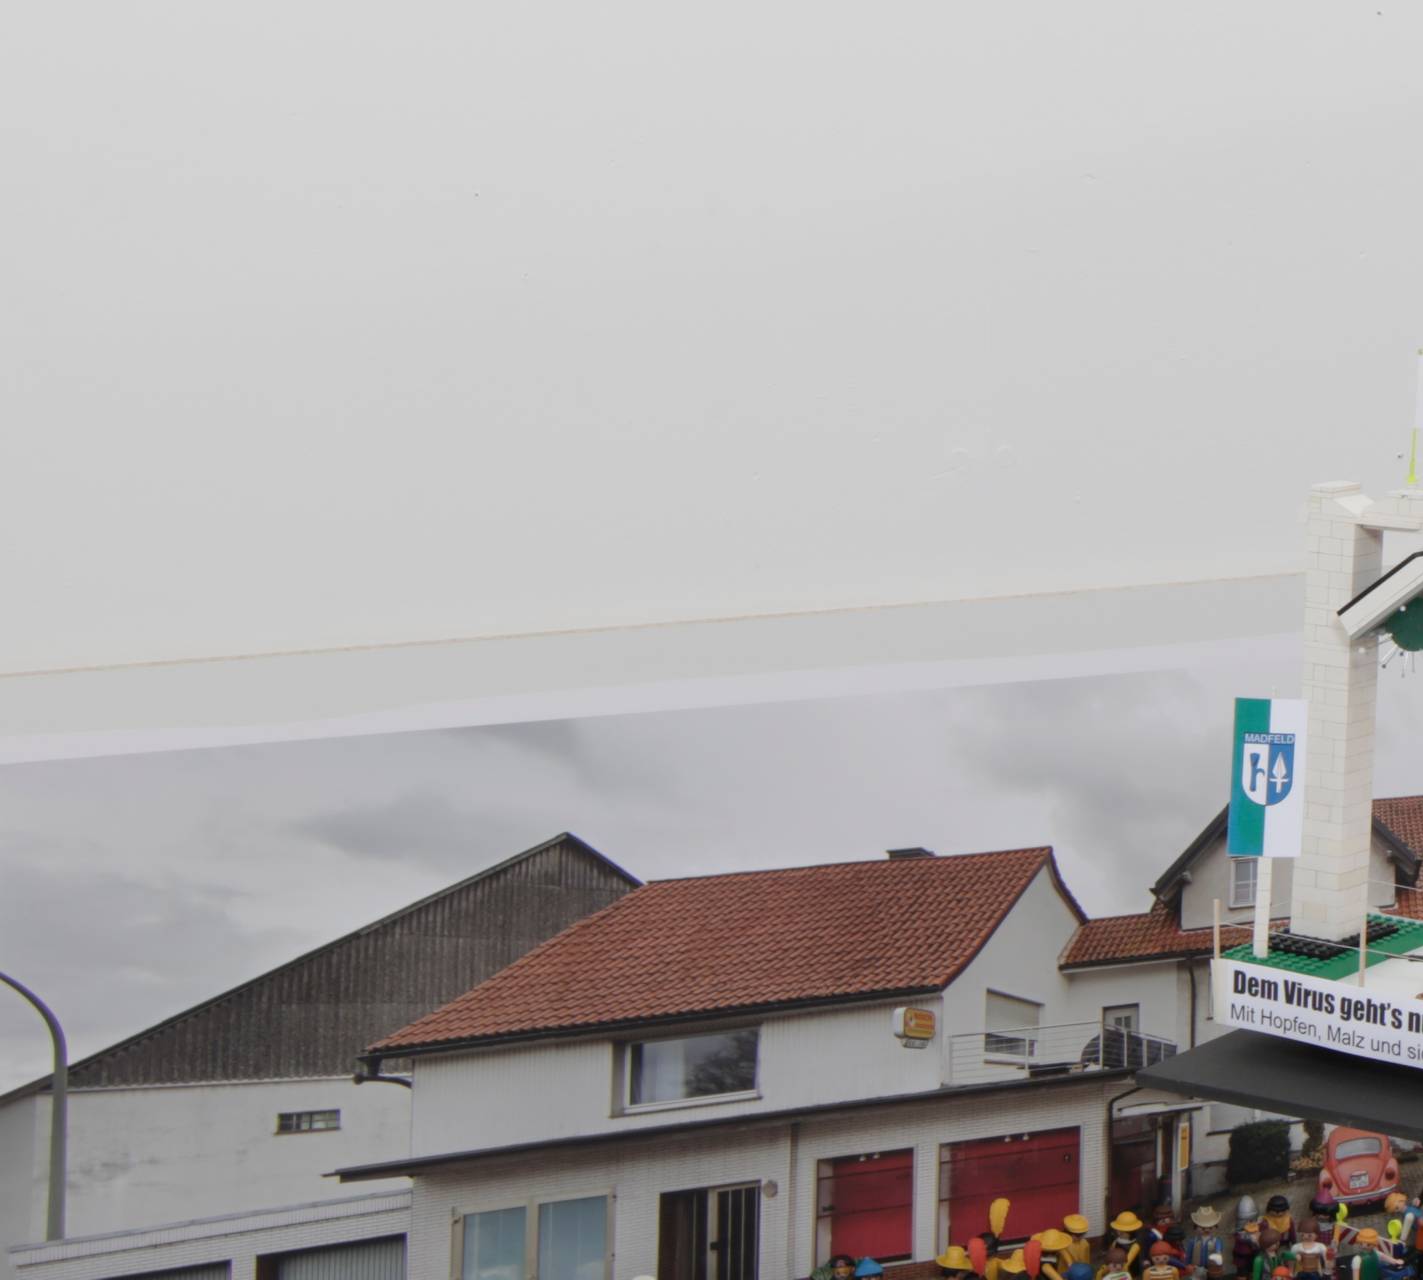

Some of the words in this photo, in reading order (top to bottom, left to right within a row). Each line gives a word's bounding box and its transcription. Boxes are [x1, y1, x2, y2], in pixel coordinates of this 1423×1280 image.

[1244, 732, 1295, 745] MADFELD
[1233, 969, 1279, 1001] Dem
[1284, 978, 1335, 1015] Virus
[1230, 1003, 1257, 1023] Mit
[1260, 1008, 1322, 1042] Hopfen,
[1326, 1024, 1366, 1050] Malz
[1370, 1033, 1402, 1057] und
